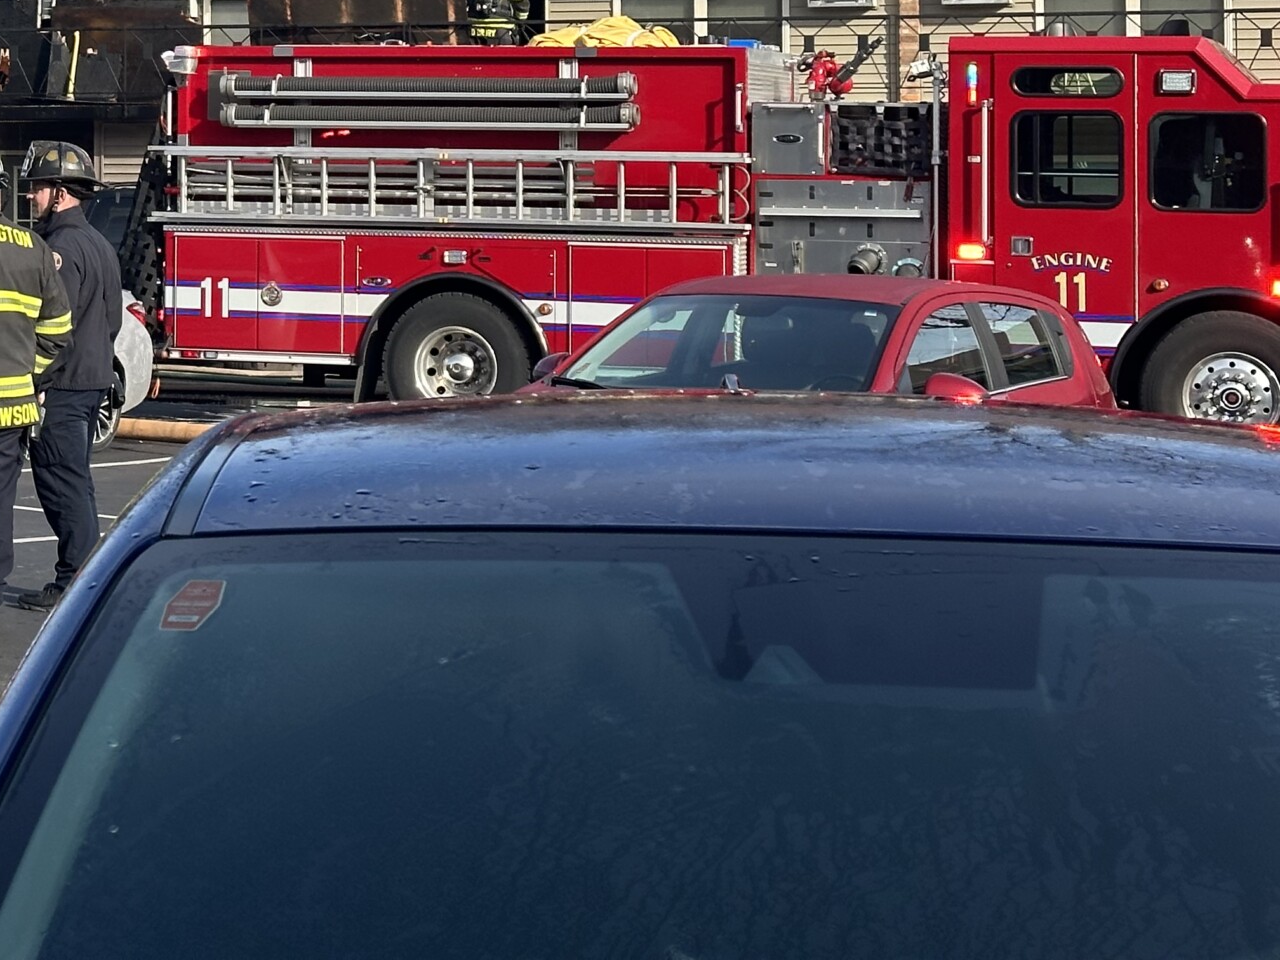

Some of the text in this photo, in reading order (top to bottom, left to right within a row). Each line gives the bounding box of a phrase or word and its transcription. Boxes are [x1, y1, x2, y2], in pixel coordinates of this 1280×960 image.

[1031, 252, 1113, 272] ENGINE
[200, 276, 230, 318] 11
[1054, 271, 1086, 312] 11
